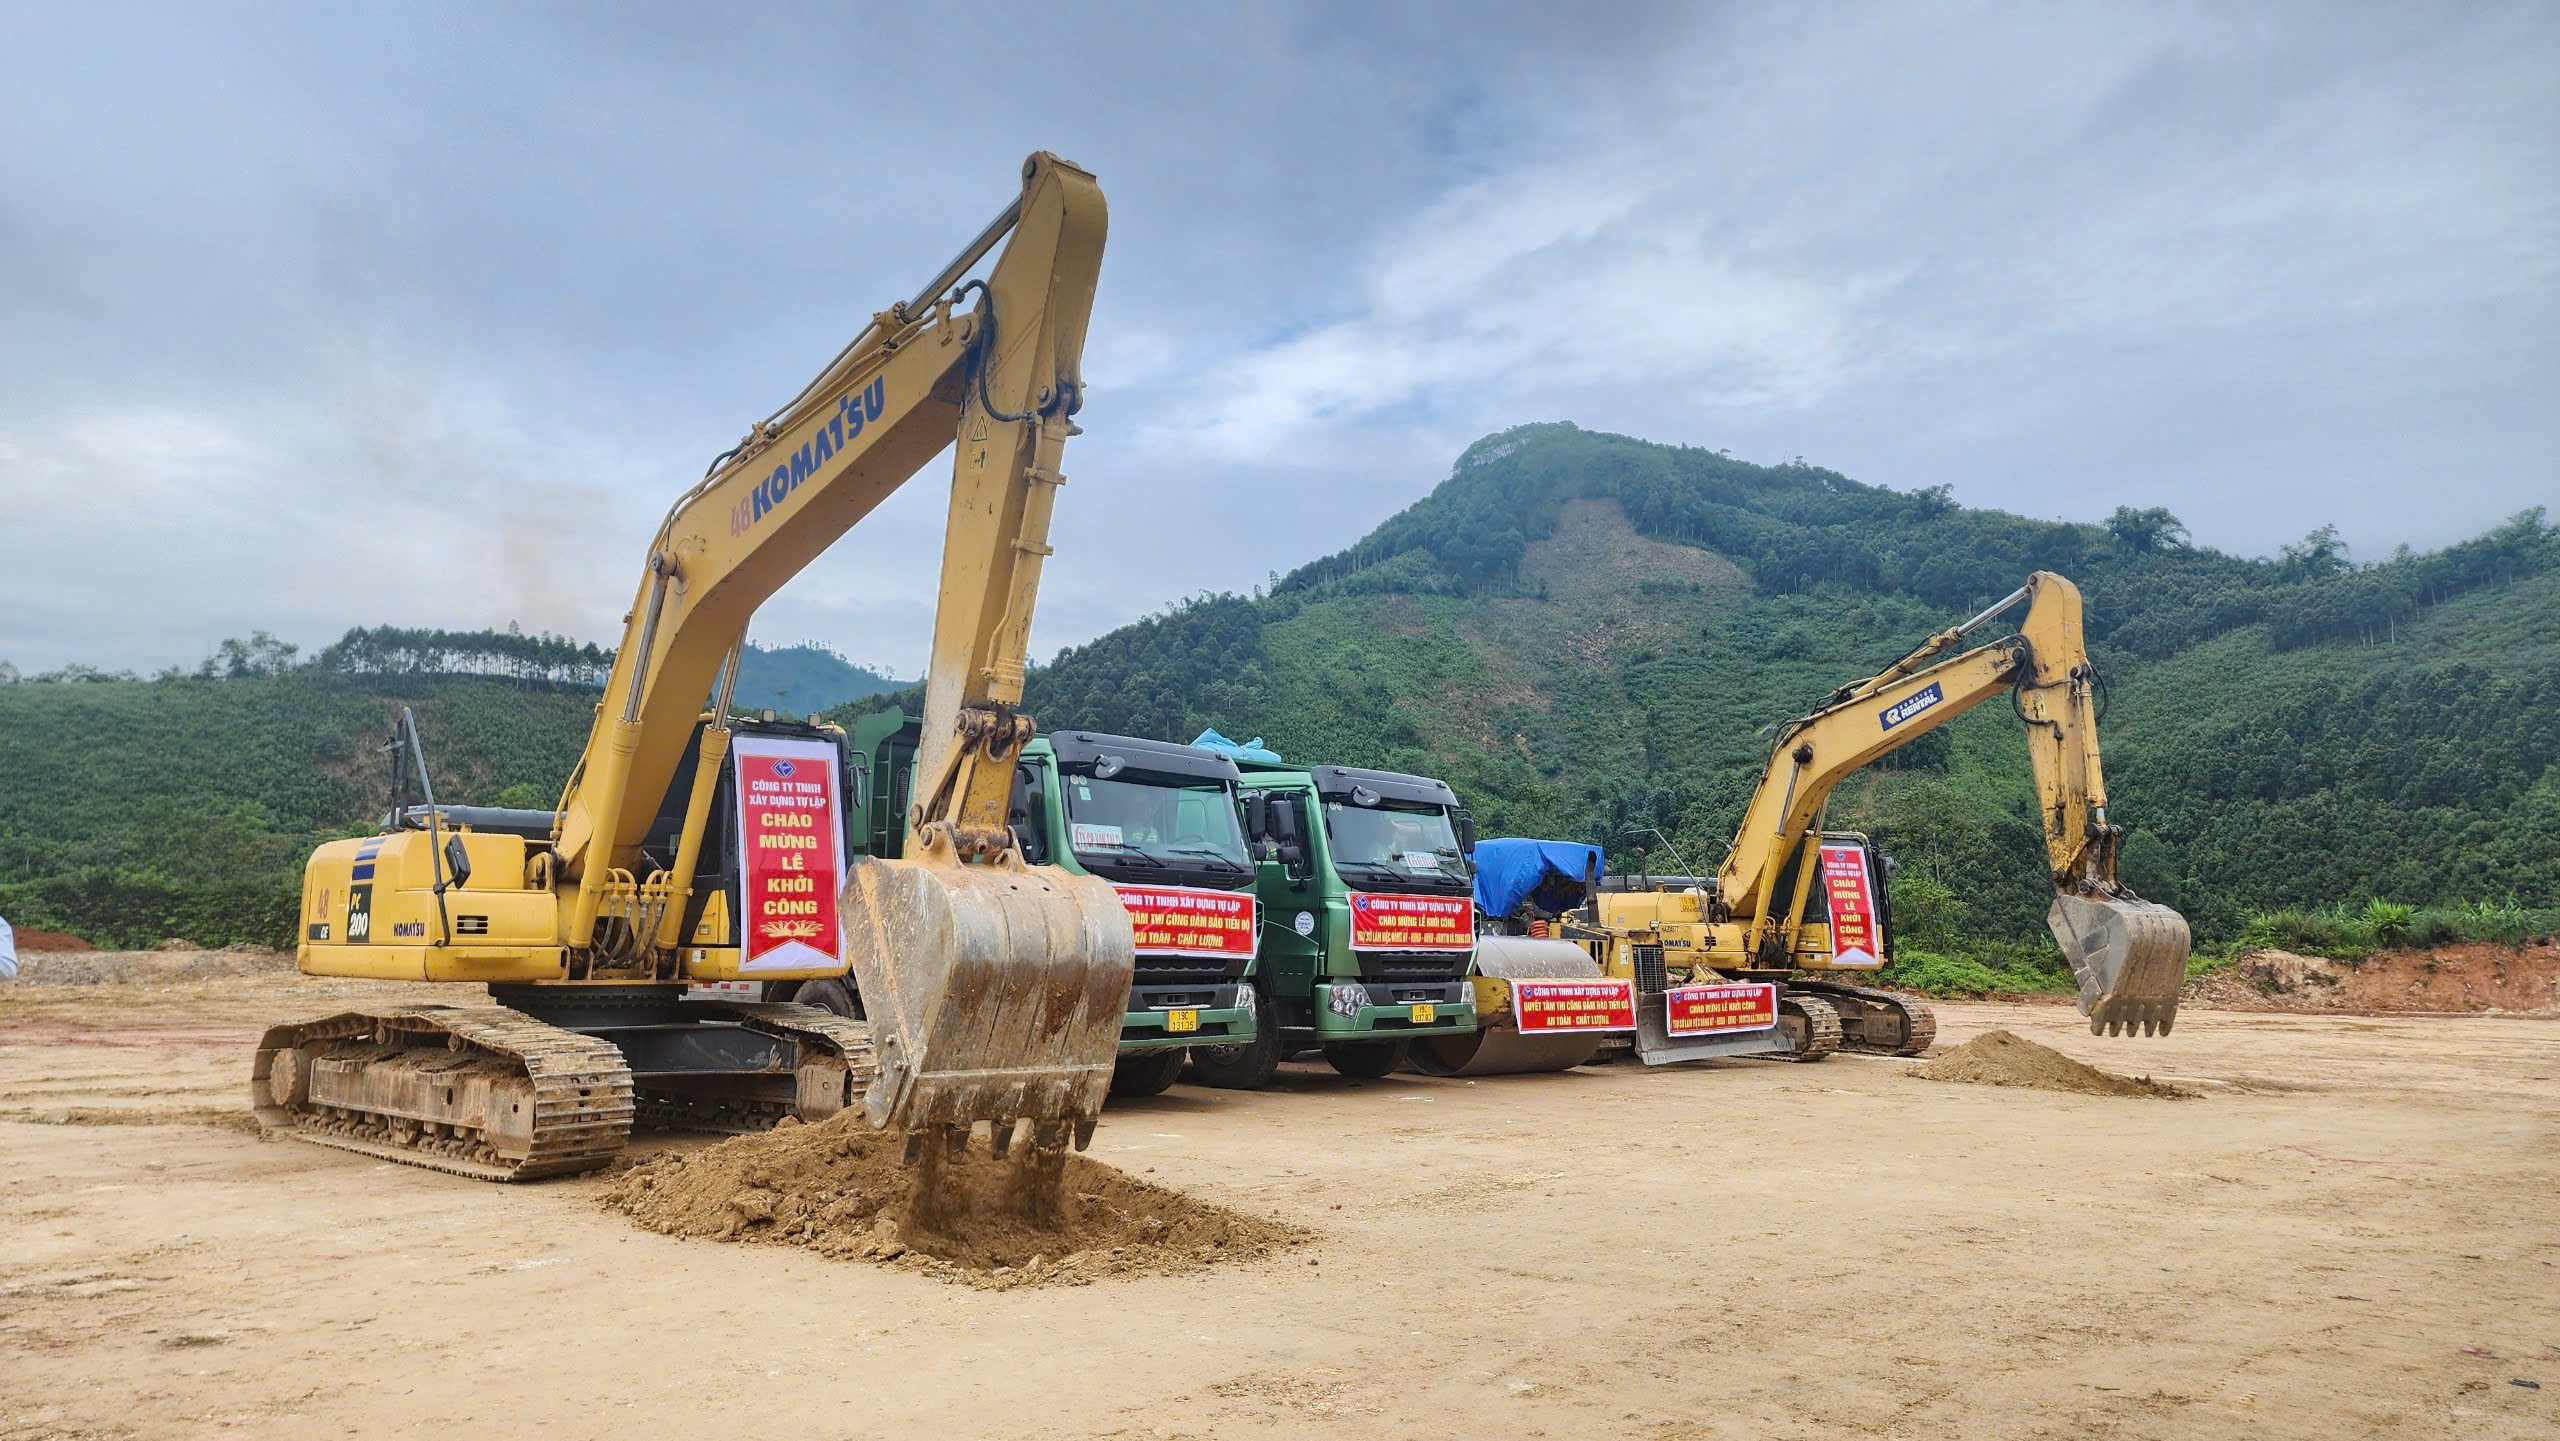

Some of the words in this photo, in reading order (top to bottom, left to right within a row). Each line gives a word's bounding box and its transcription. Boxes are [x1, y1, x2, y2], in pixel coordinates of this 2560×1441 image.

[730, 496, 750, 538] 48
[752, 376, 885, 523] KOMATSU
[1900, 694, 1938, 718] RENTAL
[752, 780, 780, 792] CÔNG
[782, 782, 793, 792] TY
[795, 782, 820, 794] TNHH
[750, 794, 767, 806] XÂY
[770, 796, 794, 808] DỰNG
[796, 796, 808, 808] TỰ
[809, 795, 826, 808] LẬP
[760, 812, 812, 828] CHÀO
[760, 834, 816, 849] MỪNG
[782, 853, 804, 870] LỄ
[767, 875, 813, 893] KHỞI
[1833, 879, 1856, 888] CHÀO
[318, 888, 329, 920] 48
[351, 893, 361, 910] PC
[764, 898, 817, 915] CÔNG
[1120, 893, 1142, 905] CÔNG
[1144, 895, 1154, 906] TY
[1156, 896, 1178, 906] TNHH
[1180, 896, 1194, 908] XÂY
[1228, 900, 1240, 912] LẬP
[1371, 898, 1389, 910] CÔNG
[1390, 901, 1398, 910] TY
[1399, 901, 1416, 910] TNHH
[348, 912, 368, 936] 200
[1166, 912, 1188, 926] CÔNG
[1840, 912, 1860, 922] KHỞI
[394, 920, 424, 936] KOMATSU
[1840, 925, 1863, 934] CÔNG
[1149, 930, 1170, 944] TOÀN
[1178, 930, 1198, 946] CHẤT
[1664, 938, 1691, 947] OMATSU
